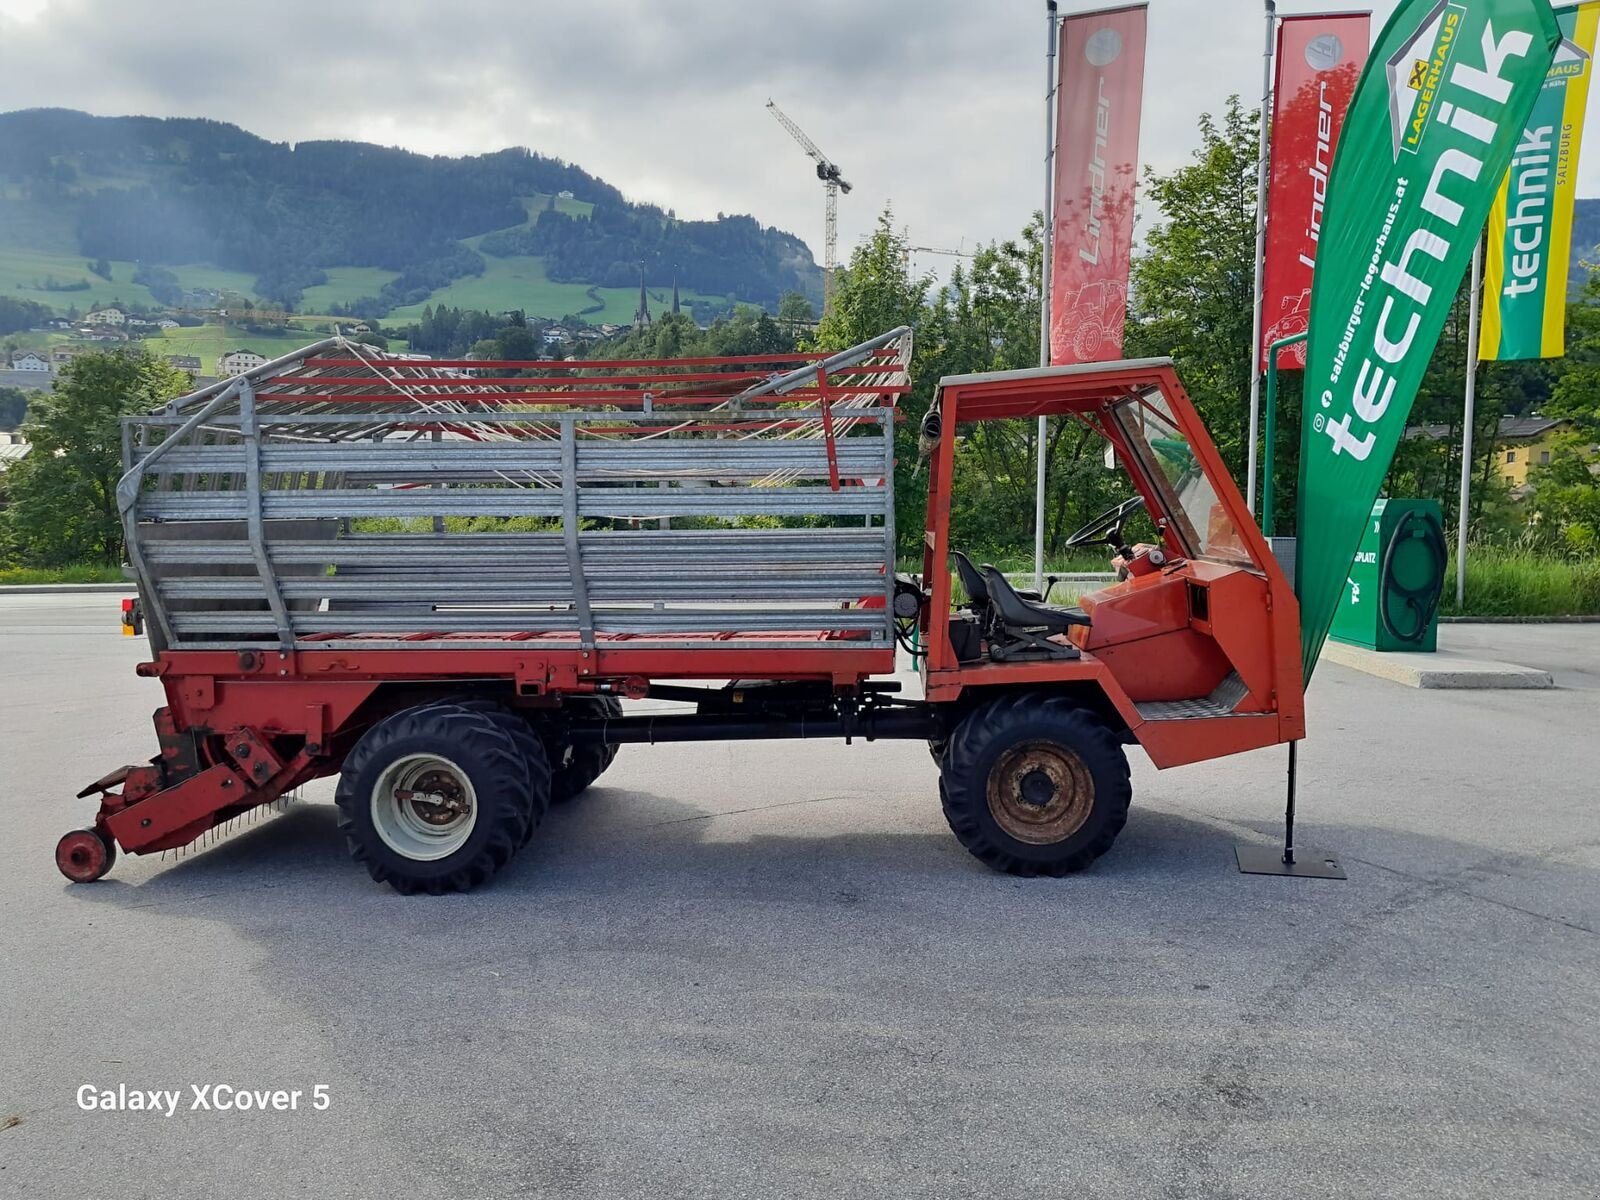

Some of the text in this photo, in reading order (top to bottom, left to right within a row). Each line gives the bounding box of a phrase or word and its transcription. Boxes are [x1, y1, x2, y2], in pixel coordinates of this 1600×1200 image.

[1407, 13, 1459, 145] LAGERHAUS
[1557, 124, 1573, 186] SALZBURG
[1078, 76, 1110, 265] Lindner
[1325, 17, 1534, 462] technik
[1503, 125, 1554, 299] technik
[1330, 176, 1409, 384] salzburger-lagerhaus.at
